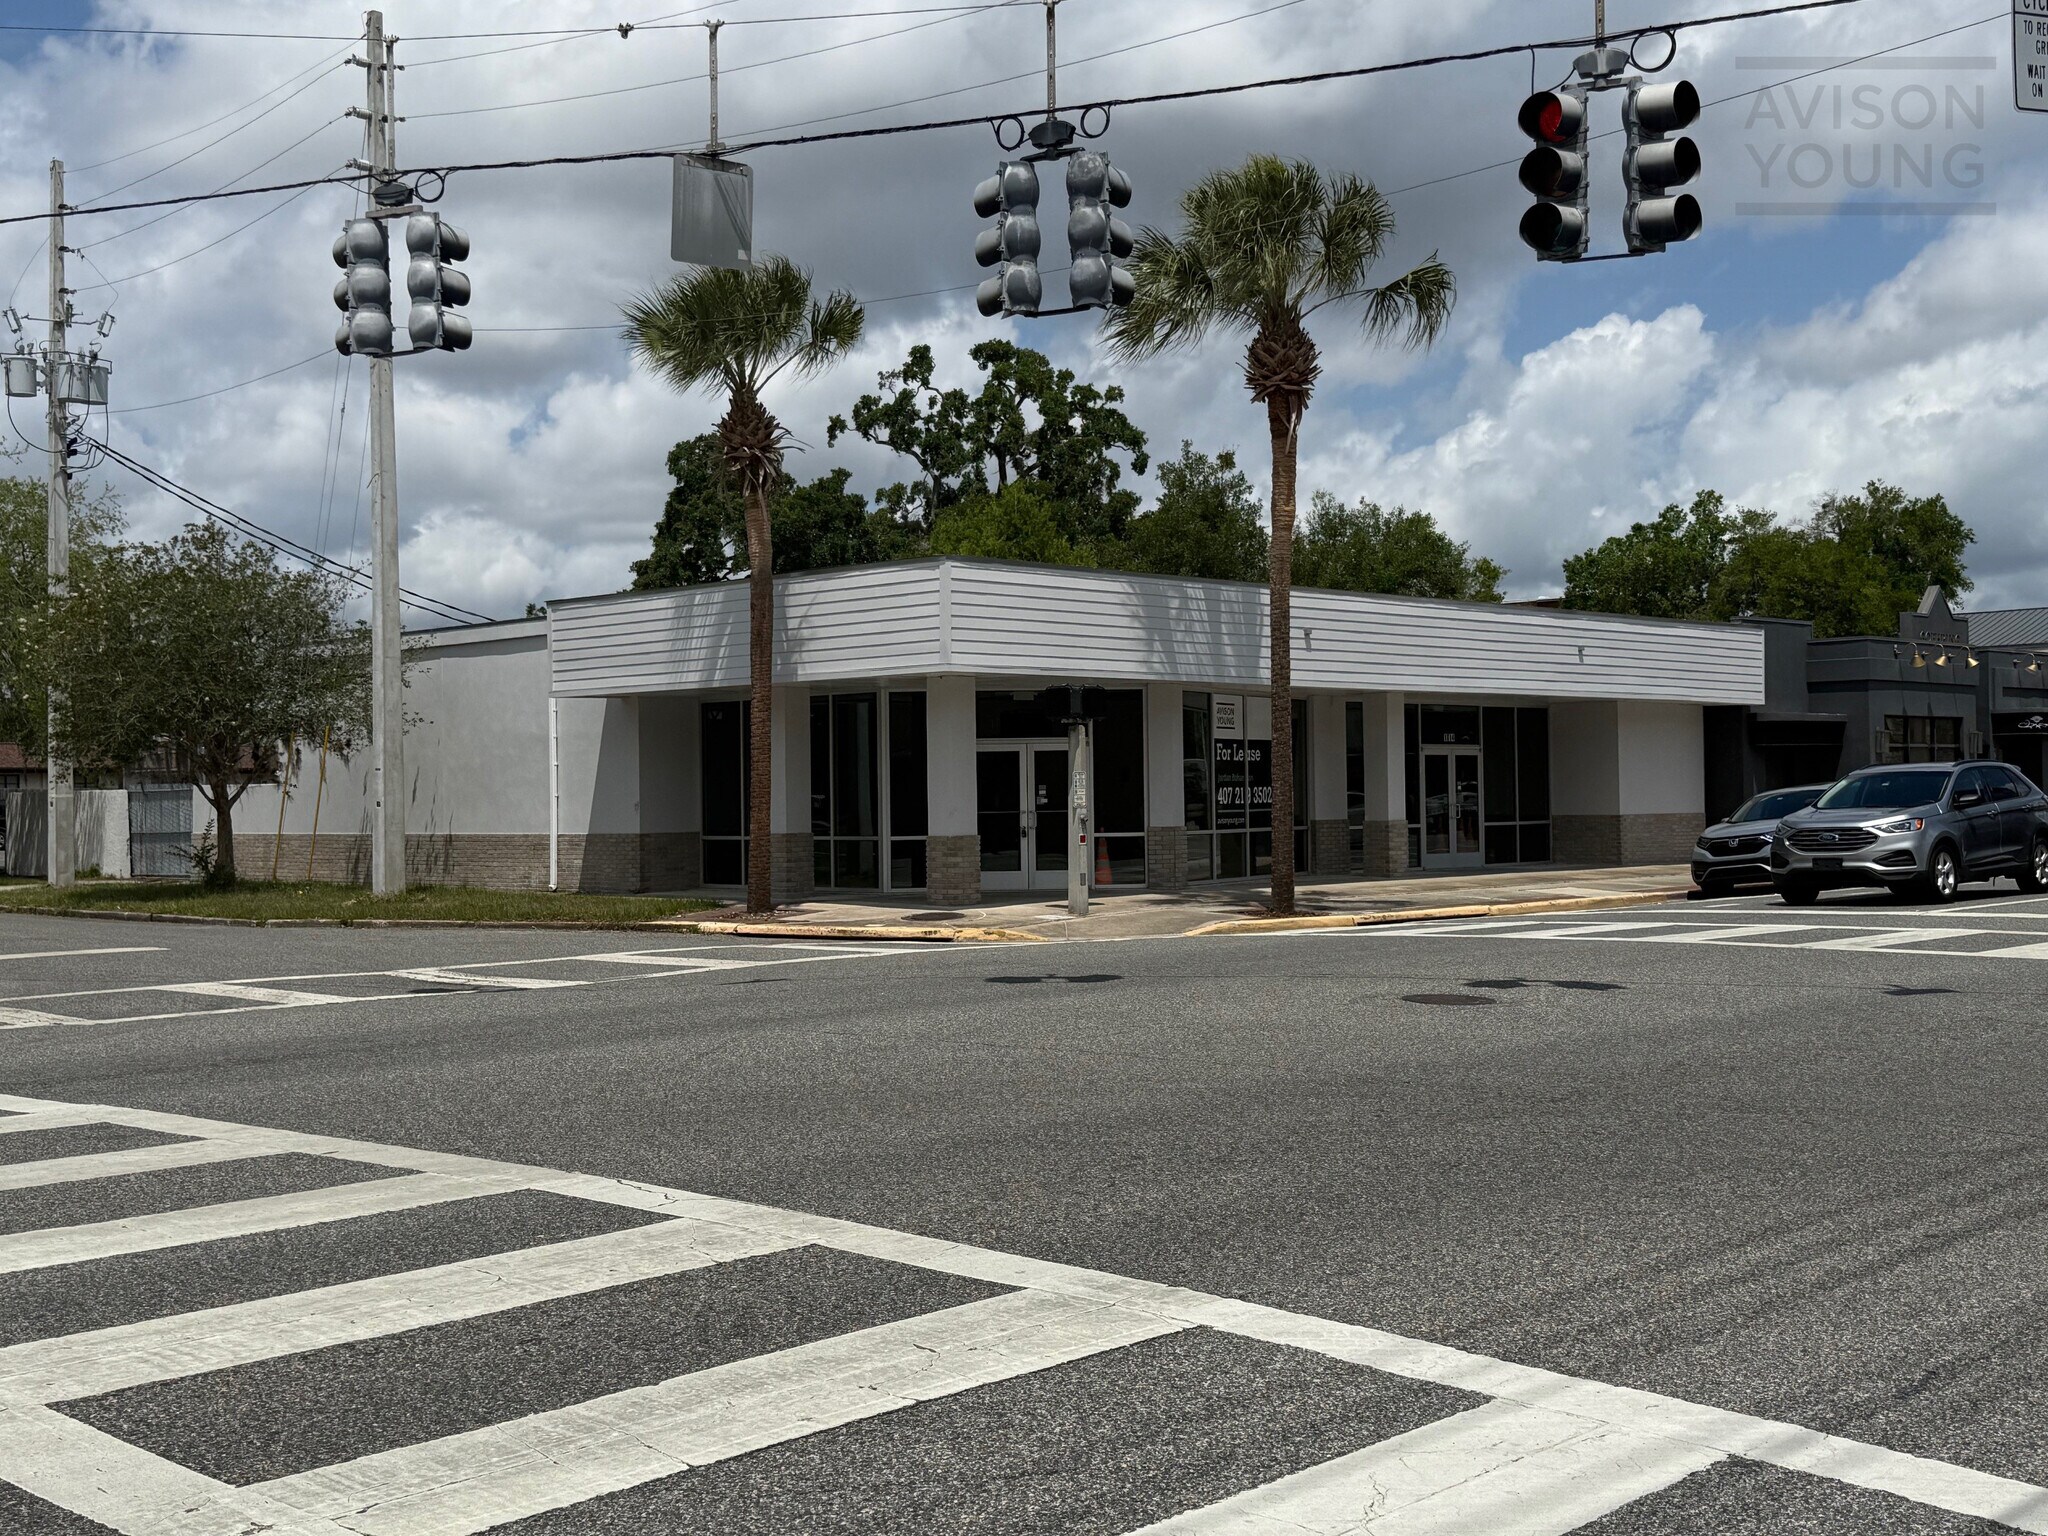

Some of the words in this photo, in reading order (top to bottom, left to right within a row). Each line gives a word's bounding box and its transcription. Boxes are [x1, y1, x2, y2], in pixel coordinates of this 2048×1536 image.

[2023, 20, 2033, 35] TO
[2036, 21, 2048, 36] RE
[2027, 64, 2045, 79] WAIT
[2031, 82, 2043, 98] ON
[1216, 716, 1235, 726] YOUNG
[1216, 743, 1231, 760] For
[1217, 787, 1233, 804] 407
[1253, 786, 1272, 803] 3502
